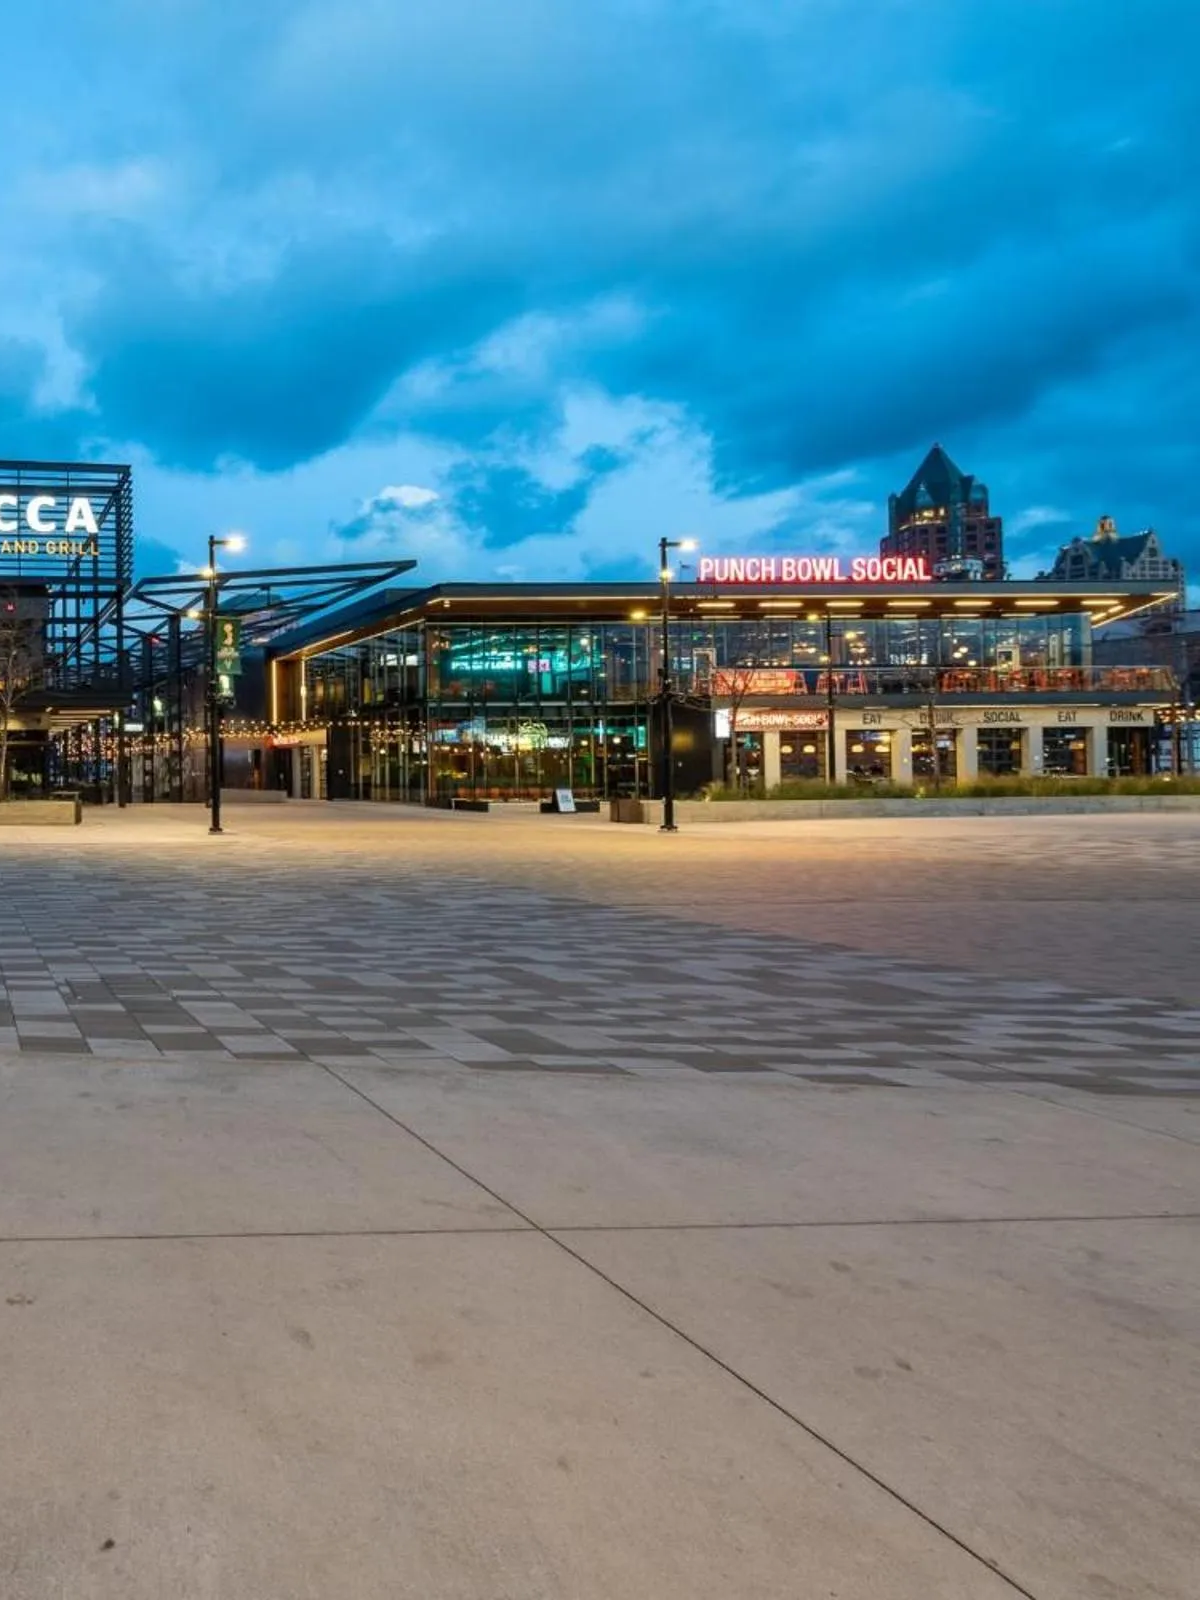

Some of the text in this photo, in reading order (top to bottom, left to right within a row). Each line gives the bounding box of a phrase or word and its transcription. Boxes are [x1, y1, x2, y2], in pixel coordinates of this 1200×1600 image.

[1, 541, 39, 554] AND
[46, 541, 99, 556] GRILL
[700, 557, 931, 581] PUNCH BOWL SOCIAL
[862, 711, 1144, 725] EAT DINK SOCIAL EAT DRINK
